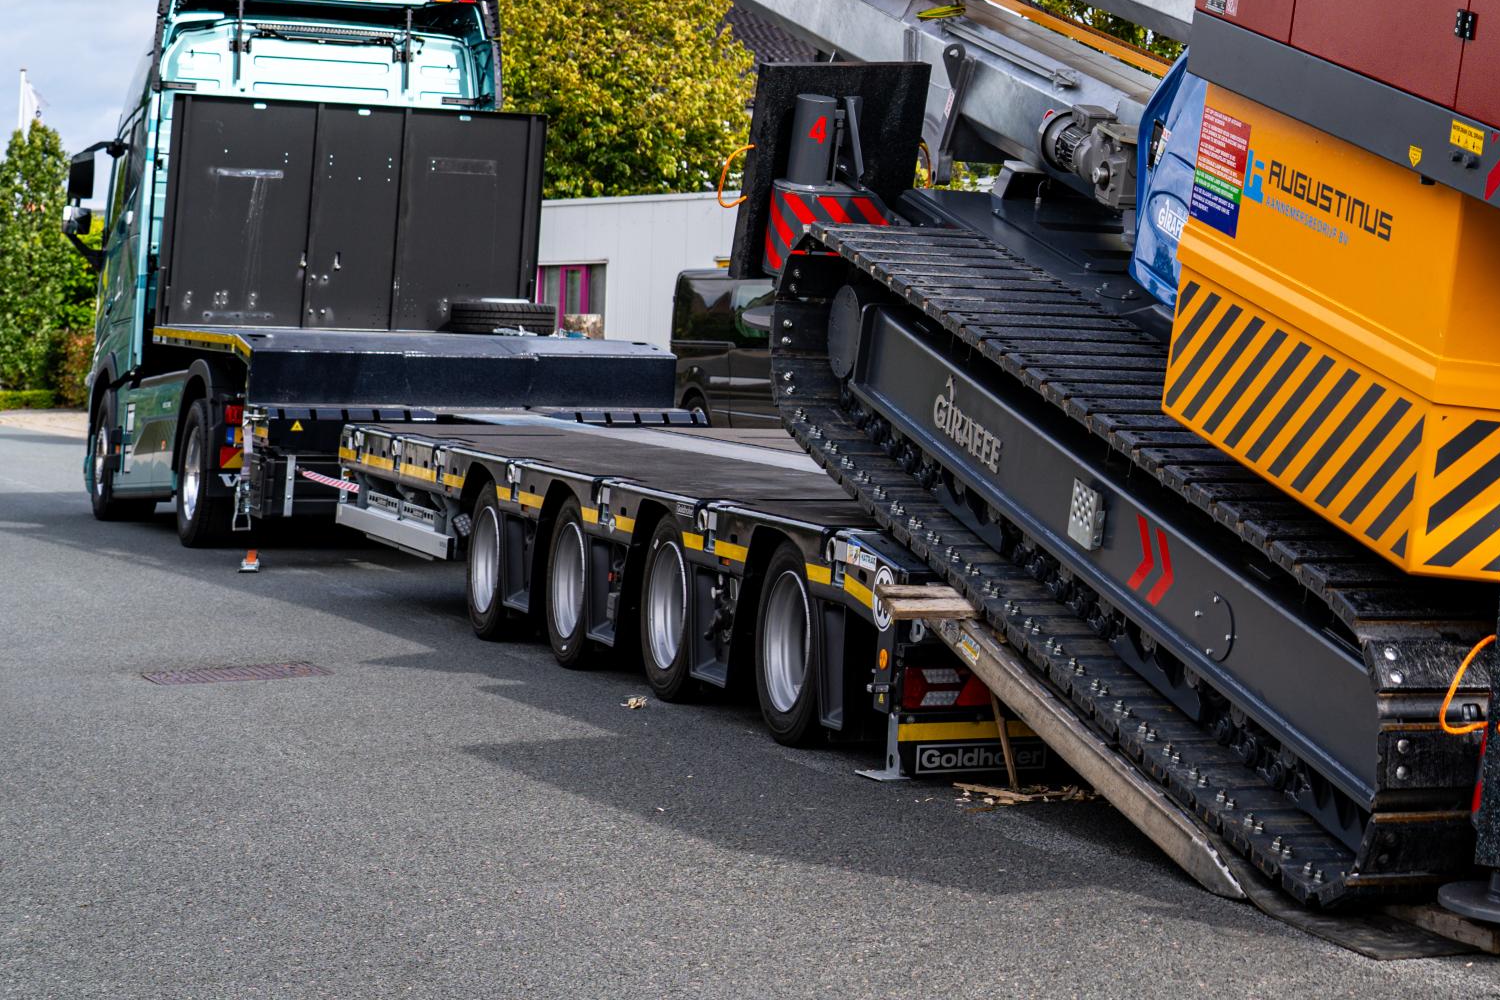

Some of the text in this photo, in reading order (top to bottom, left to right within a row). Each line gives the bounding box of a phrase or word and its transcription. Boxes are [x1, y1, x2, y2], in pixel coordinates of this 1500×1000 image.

[807, 115, 828, 145] 4
[1268, 159, 1393, 242] AUGUSTINUS
[933, 374, 1001, 474] GIRAFFE
[920, 748, 1042, 769] Goldhoer
